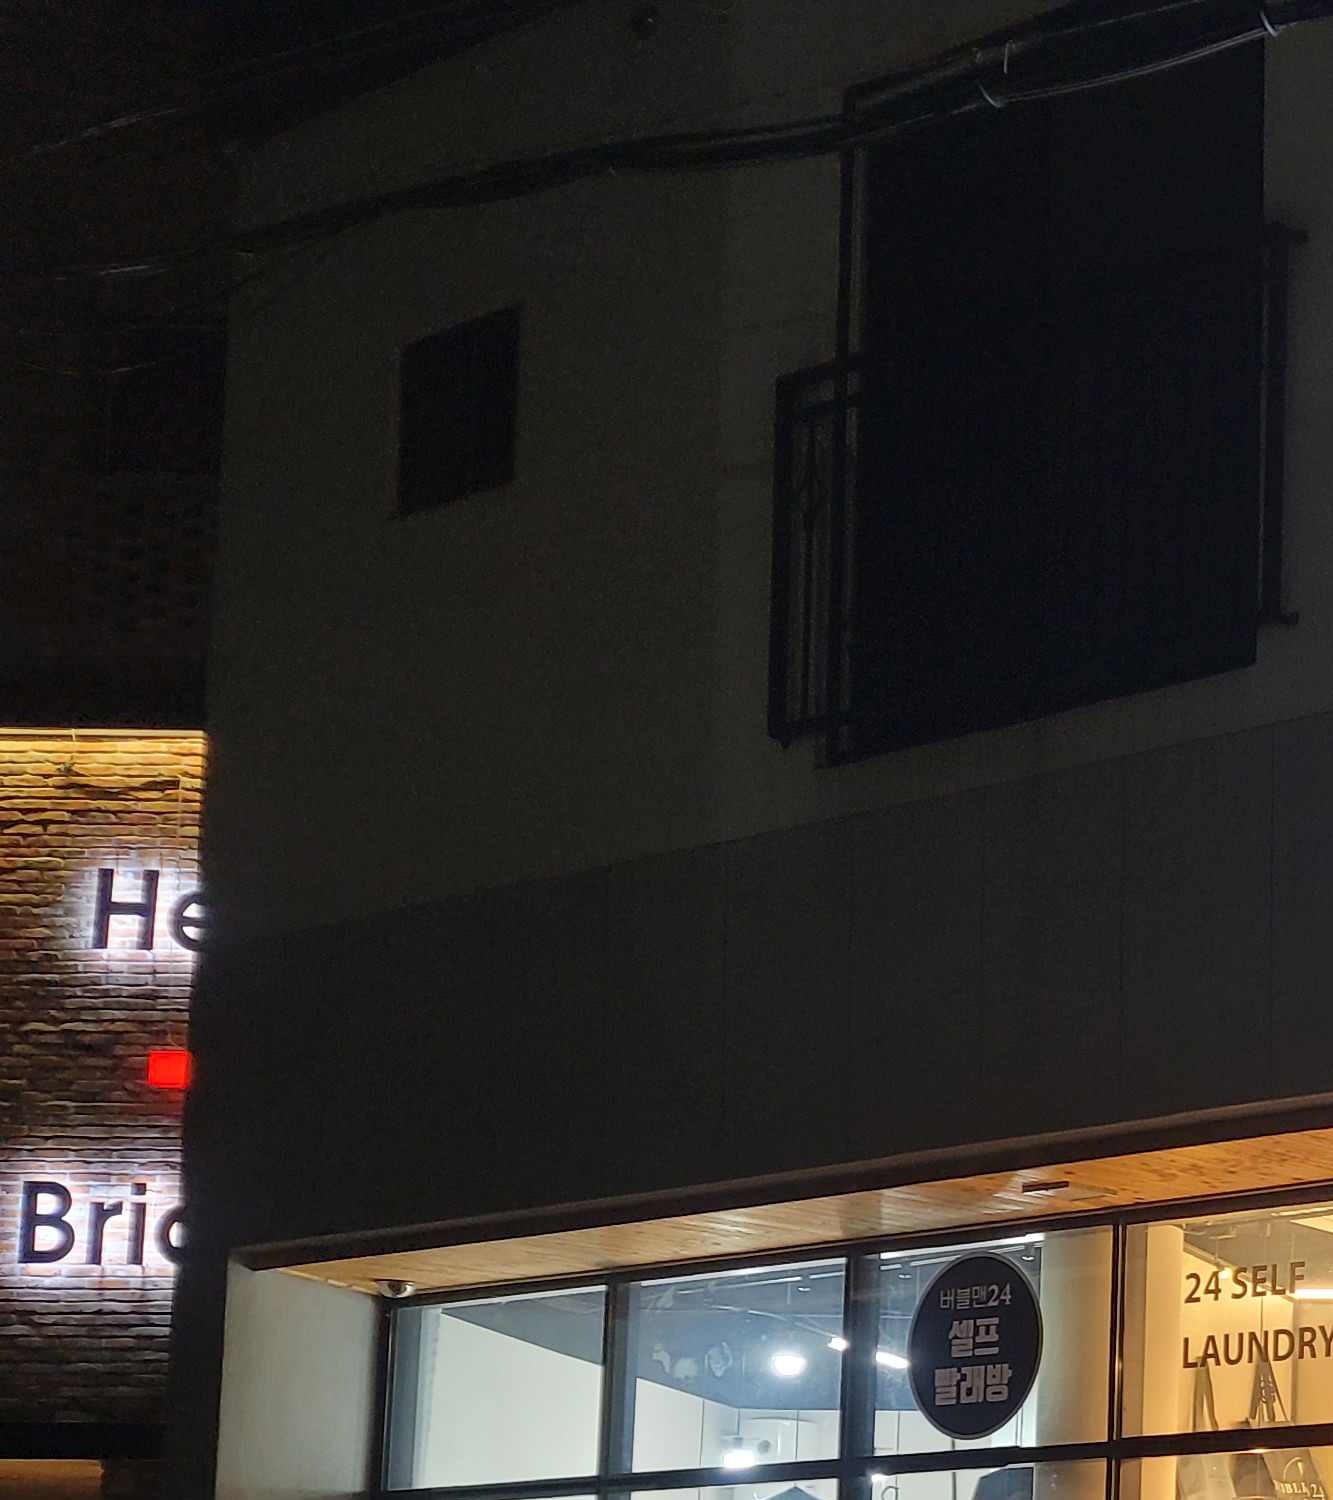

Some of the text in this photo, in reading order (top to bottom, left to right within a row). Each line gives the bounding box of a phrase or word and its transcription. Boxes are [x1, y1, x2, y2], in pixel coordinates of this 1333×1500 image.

[939, 1282, 1012, 1310] 버블맨24
[1183, 1261, 1306, 1304] 24 SELF
[948, 1317, 1000, 1358] 셀프
[934, 1363, 1013, 1406] 빨래방
